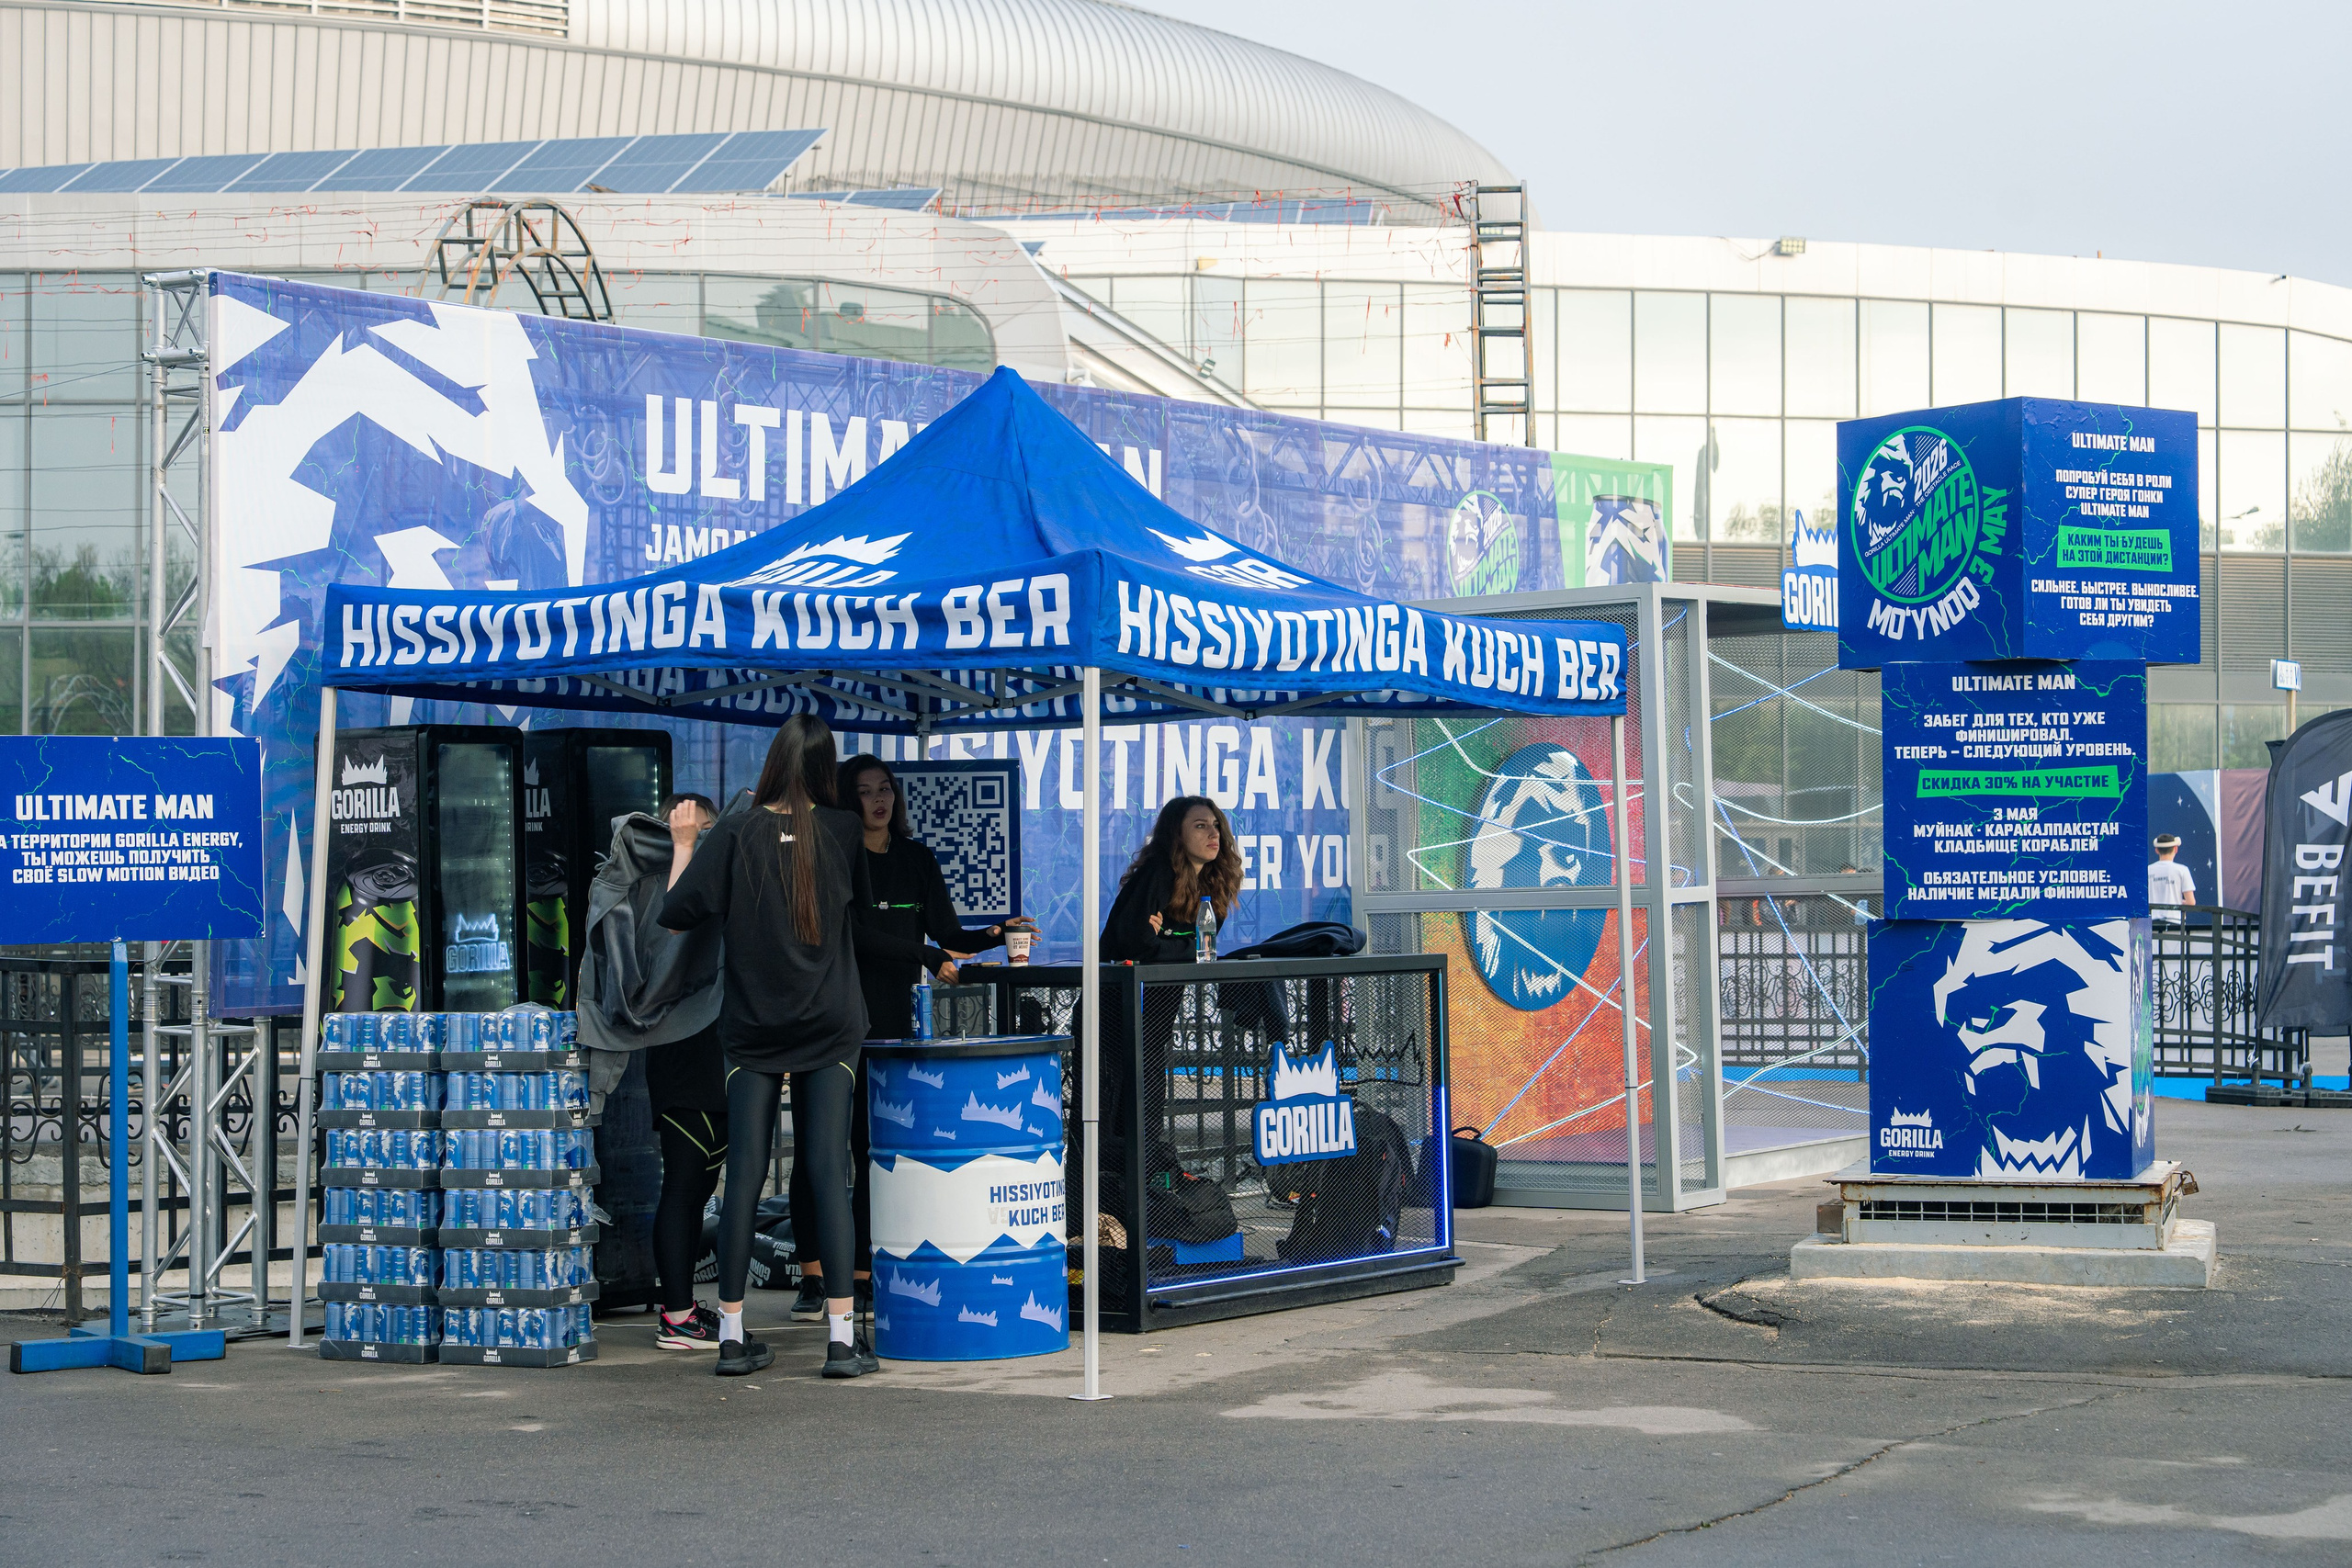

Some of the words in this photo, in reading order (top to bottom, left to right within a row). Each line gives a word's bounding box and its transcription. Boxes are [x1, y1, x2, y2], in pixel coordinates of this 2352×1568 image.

[646, 394, 928, 503] ULTIM
[2073, 433, 2127, 451] ULTIMATE
[2130, 436, 2155, 452] MAN
[1915, 438, 1947, 503] 2026
[2056, 468, 2108, 485] ПОПРОБУЙ
[2109, 472, 2135, 486] СЕБЯ
[2137, 474, 2143, 487] В
[2145, 474, 2172, 489] РОЛИ
[2065, 485, 2098, 500] СУПЕР
[2100, 488, 2130, 502] ГЕРОЯ
[2132, 489, 2163, 503] ГОНКИ
[1865, 540, 1884, 558] GORILLA
[1884, 520, 1905, 545] ULTIMATE
[1916, 498, 1926, 508] THE
[1924, 471, 1948, 499] OBSTACLE
[1947, 460, 1962, 475] RACE
[2080, 502, 2126, 517] ULTIMATE
[2128, 505, 2149, 518] MAN
[1872, 470, 1973, 589] ULTIMATE
[1978, 486, 2008, 556] MAY
[645, 524, 756, 562] JAMO
[2067, 533, 2101, 547] КАКИМ
[2104, 535, 2119, 547] ТЫ
[2121, 536, 2163, 550] БУДЕШЬ
[1918, 507, 1973, 596] MAN
[2063, 549, 2075, 562] НА
[2078, 548, 2102, 562] ЭТОЙ
[2105, 551, 2168, 566] ДИСТАНЦИИ?
[1969, 554, 1996, 584] 3
[2031, 579, 2079, 593] СИЛЬНЕЕ.
[2081, 581, 2130, 595] БЫСТРЕЕ.
[2132, 582, 2199, 598] ВЫНОСЛИВЕЕ.
[1784, 573, 1838, 627] GORI
[2061, 596, 2092, 609] ГОТОВ
[2094, 597, 2108, 610] ЛИ
[2110, 598, 2125, 611] ТЫ
[2128, 599, 2172, 614] УВИДЕТЬ
[340, 580, 727, 667] HISSIYOTINGA
[752, 590, 922, 650] KUCH
[943, 572, 1070, 649] BER
[2080, 613, 2105, 626] СЕБЯ
[2107, 614, 2154, 627] ДРУГИМ?
[1118, 580, 1429, 676] HISSIYOTINGA
[1442, 617, 1544, 697] KUCH
[1555, 637, 1621, 700] BER
[1952, 675, 2033, 692] ULTIMATE
[2038, 674, 2075, 691] MAN
[1924, 714, 1968, 728] ЗАБЕГ
[1972, 714, 2004, 728] ДЛЯ
[2007, 713, 2038, 728] ТЕХ,
[2041, 713, 2069, 726] КТО
[2073, 712, 2105, 726] УЖЕ
[1955, 728, 2073, 742] ФИНИШИРОВАЛ.
[1894, 746, 1947, 759] ТЕПЕРЬ
[1963, 742, 2062, 760] СЛЕДУЮЩИЙ
[2065, 742, 2136, 757] УРОВЕНЬ.
[1922, 777, 1981, 791] СКИДКА
[1984, 776, 2018, 789] 30%
[2021, 776, 2041, 789] НА
[2044, 775, 2109, 788] УЧАСТИЕ
[16, 795, 147, 820] ULTIMATE
[156, 795, 213, 819] MAN
[331, 787, 401, 819] GORILLA
[1994, 808, 2003, 820] 3
[2007, 807, 2038, 820] МАЯ
[341, 823, 368, 834] ENERGY
[369, 822, 391, 833] DRINK
[1914, 821, 1973, 838] МУЙНАК
[1984, 822, 2119, 836] КАРАКАЛПАКСТАН
[0, 834, 7, 849] А
[11, 833, 110, 849] ТЕРРИТОРИИ
[116, 832, 179, 848] GORILLA
[183, 832, 243, 849] ENERGY,
[1935, 840, 2018, 854] КЛАДБИЩЕ
[2021, 835, 2098, 852] КОРАБЛЕЙ
[22, 852, 47, 866] ТЫ
[51, 851, 125, 865] МОЖЕШЬ
[129, 850, 210, 864] ПОЛУЧИТЬ
[13, 866, 54, 884] СВОЁ
[58, 867, 103, 883] SLOW
[107, 866, 164, 882] MOTION
[169, 865, 220, 882] ВИДЕО
[1923, 871, 2035, 885] ОБЯЗАТЕЛЬНОЕ
[2039, 870, 2110, 884] УСЛОВИЕ:
[1907, 887, 1973, 900] НАЛИЧИЕ
[1978, 886, 2041, 901] МЕДАЛИ
[2044, 886, 2128, 898] ФИНИШЕРА
[2287, 844, 2345, 970] BEFIT
[447, 942, 511, 973] GORILLA
[1260, 1101, 1355, 1158] GORILLA
[1880, 1128, 1943, 1148] GORILLA
[1009, 1207, 1047, 1226] KUCH
[483, 1355, 501, 1363] GORILLA
